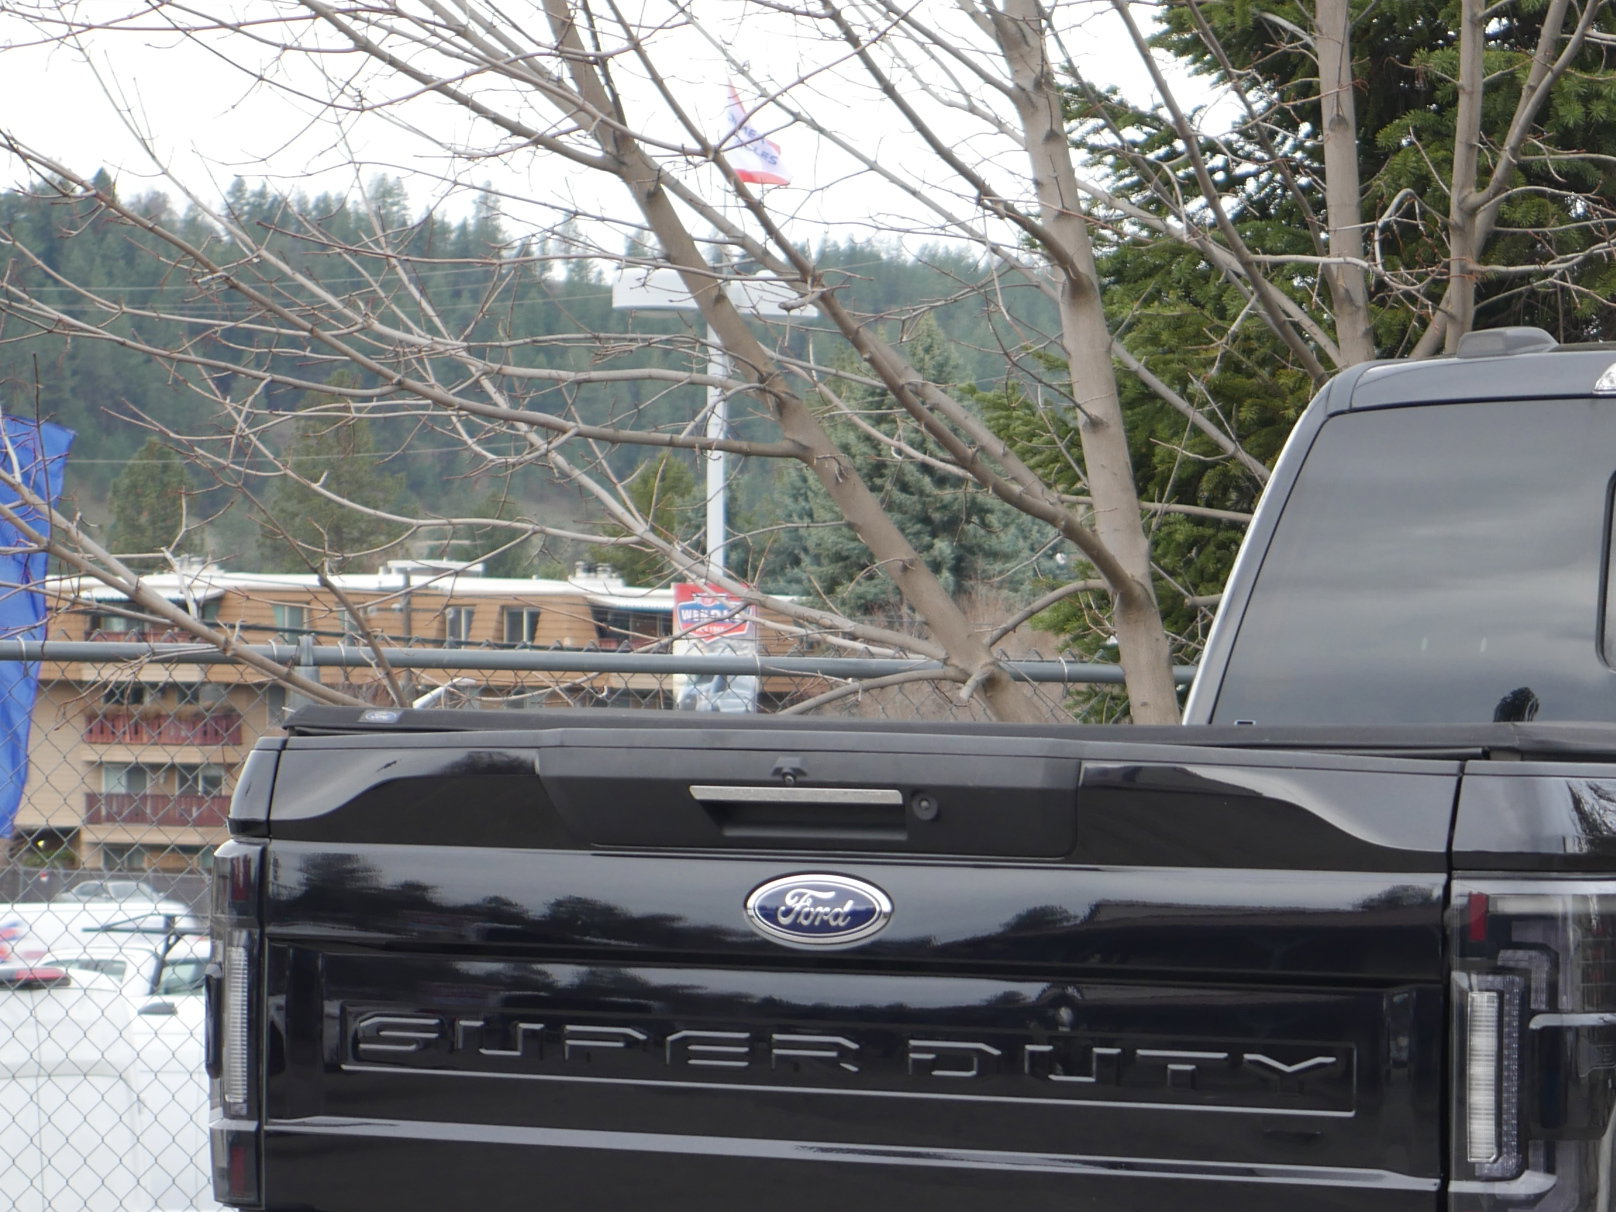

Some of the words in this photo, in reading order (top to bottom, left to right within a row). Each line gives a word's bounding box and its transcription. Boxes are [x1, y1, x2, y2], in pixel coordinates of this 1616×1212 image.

[777, 888, 854, 927] Ford
[356, 1009, 860, 1074] SUPER
[906, 1038, 1338, 1095] DUTY
